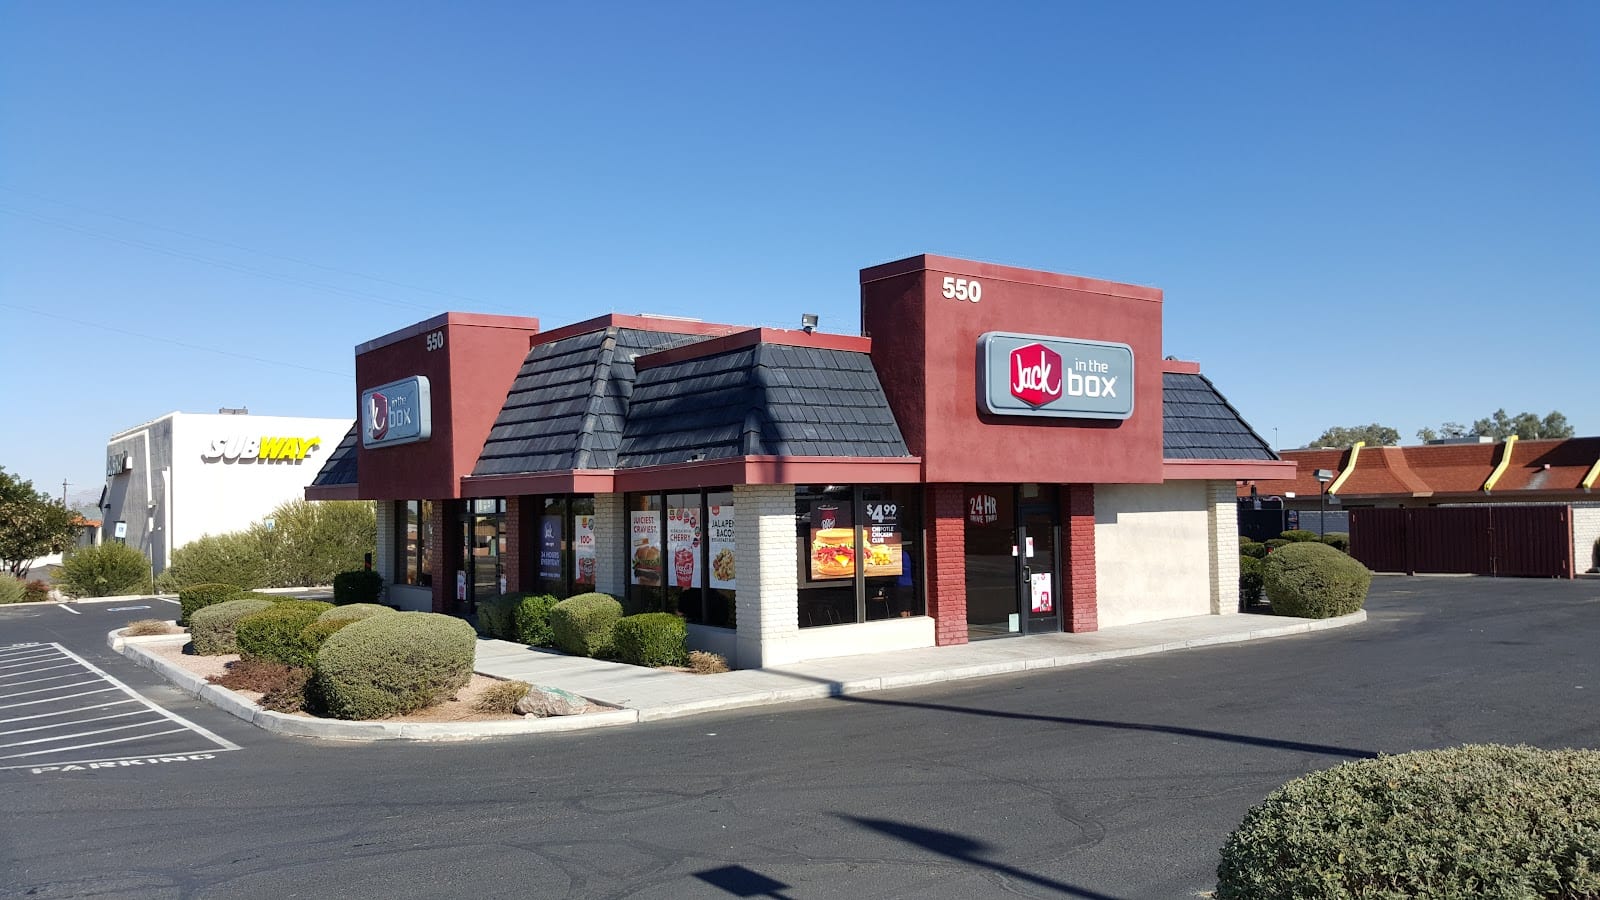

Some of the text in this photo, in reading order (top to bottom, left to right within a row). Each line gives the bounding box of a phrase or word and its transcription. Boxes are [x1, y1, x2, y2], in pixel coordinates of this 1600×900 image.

[942, 276, 982, 303] 550
[426, 330, 444, 351] 550
[1013, 351, 1061, 396] Jack
[1074, 358, 1109, 374] in the
[1067, 367, 1117, 398] box
[388, 406, 412, 429] box
[203, 435, 321, 462] SUBWAY
[969, 494, 998, 515] 24 HR
[670, 533, 691, 542] CHERRY
[31, 754, 216, 774] PARKING
